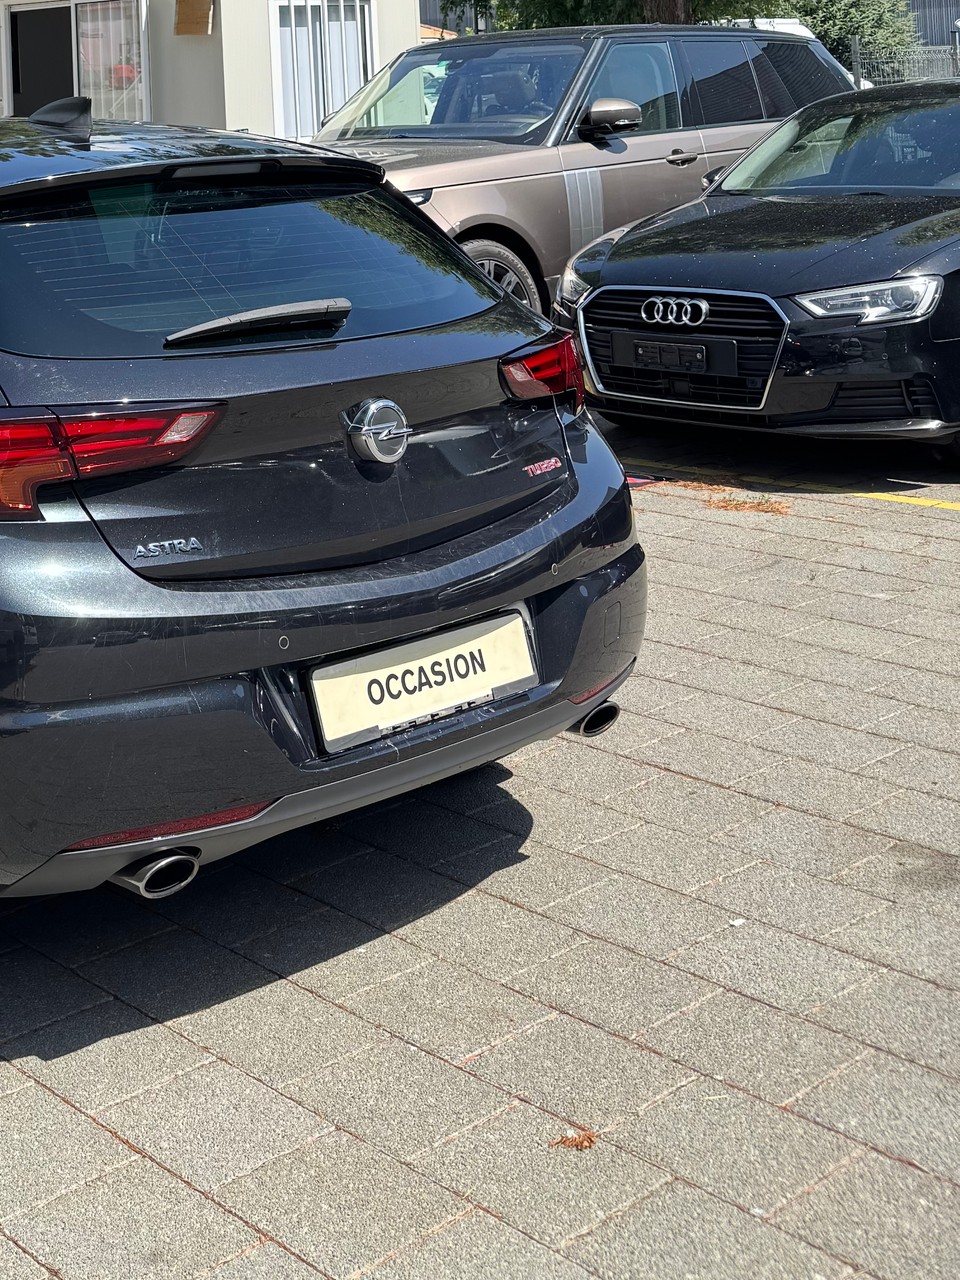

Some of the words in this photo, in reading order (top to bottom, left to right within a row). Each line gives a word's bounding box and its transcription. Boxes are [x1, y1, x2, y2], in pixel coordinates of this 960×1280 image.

[522, 457, 562, 477] TURBO
[133, 537, 203, 560] ASTRA
[367, 648, 487, 705] OCCASION
